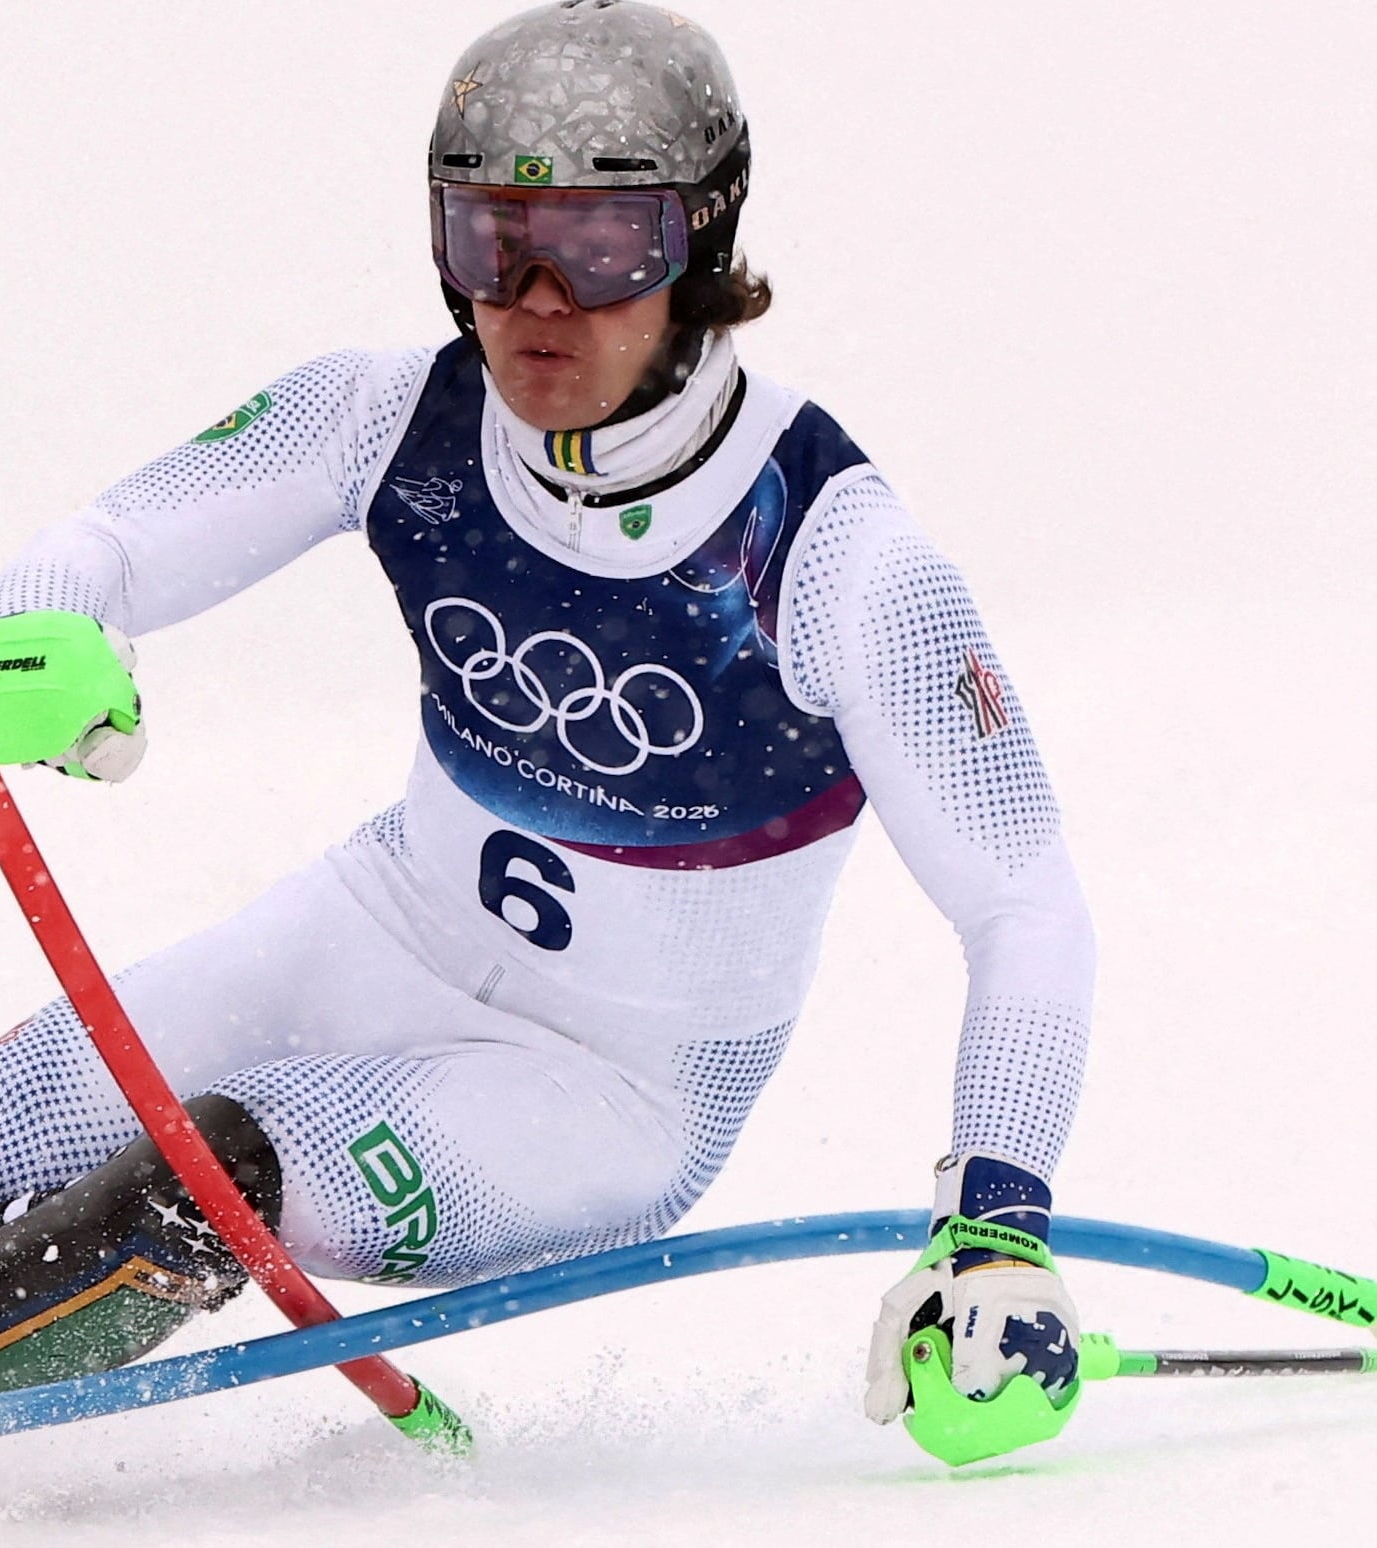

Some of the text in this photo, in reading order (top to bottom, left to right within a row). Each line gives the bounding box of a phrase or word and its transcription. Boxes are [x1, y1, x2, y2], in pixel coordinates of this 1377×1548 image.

[431, 692, 721, 820] MILANO CORTINA 2026
[478, 829, 576, 951] 6
